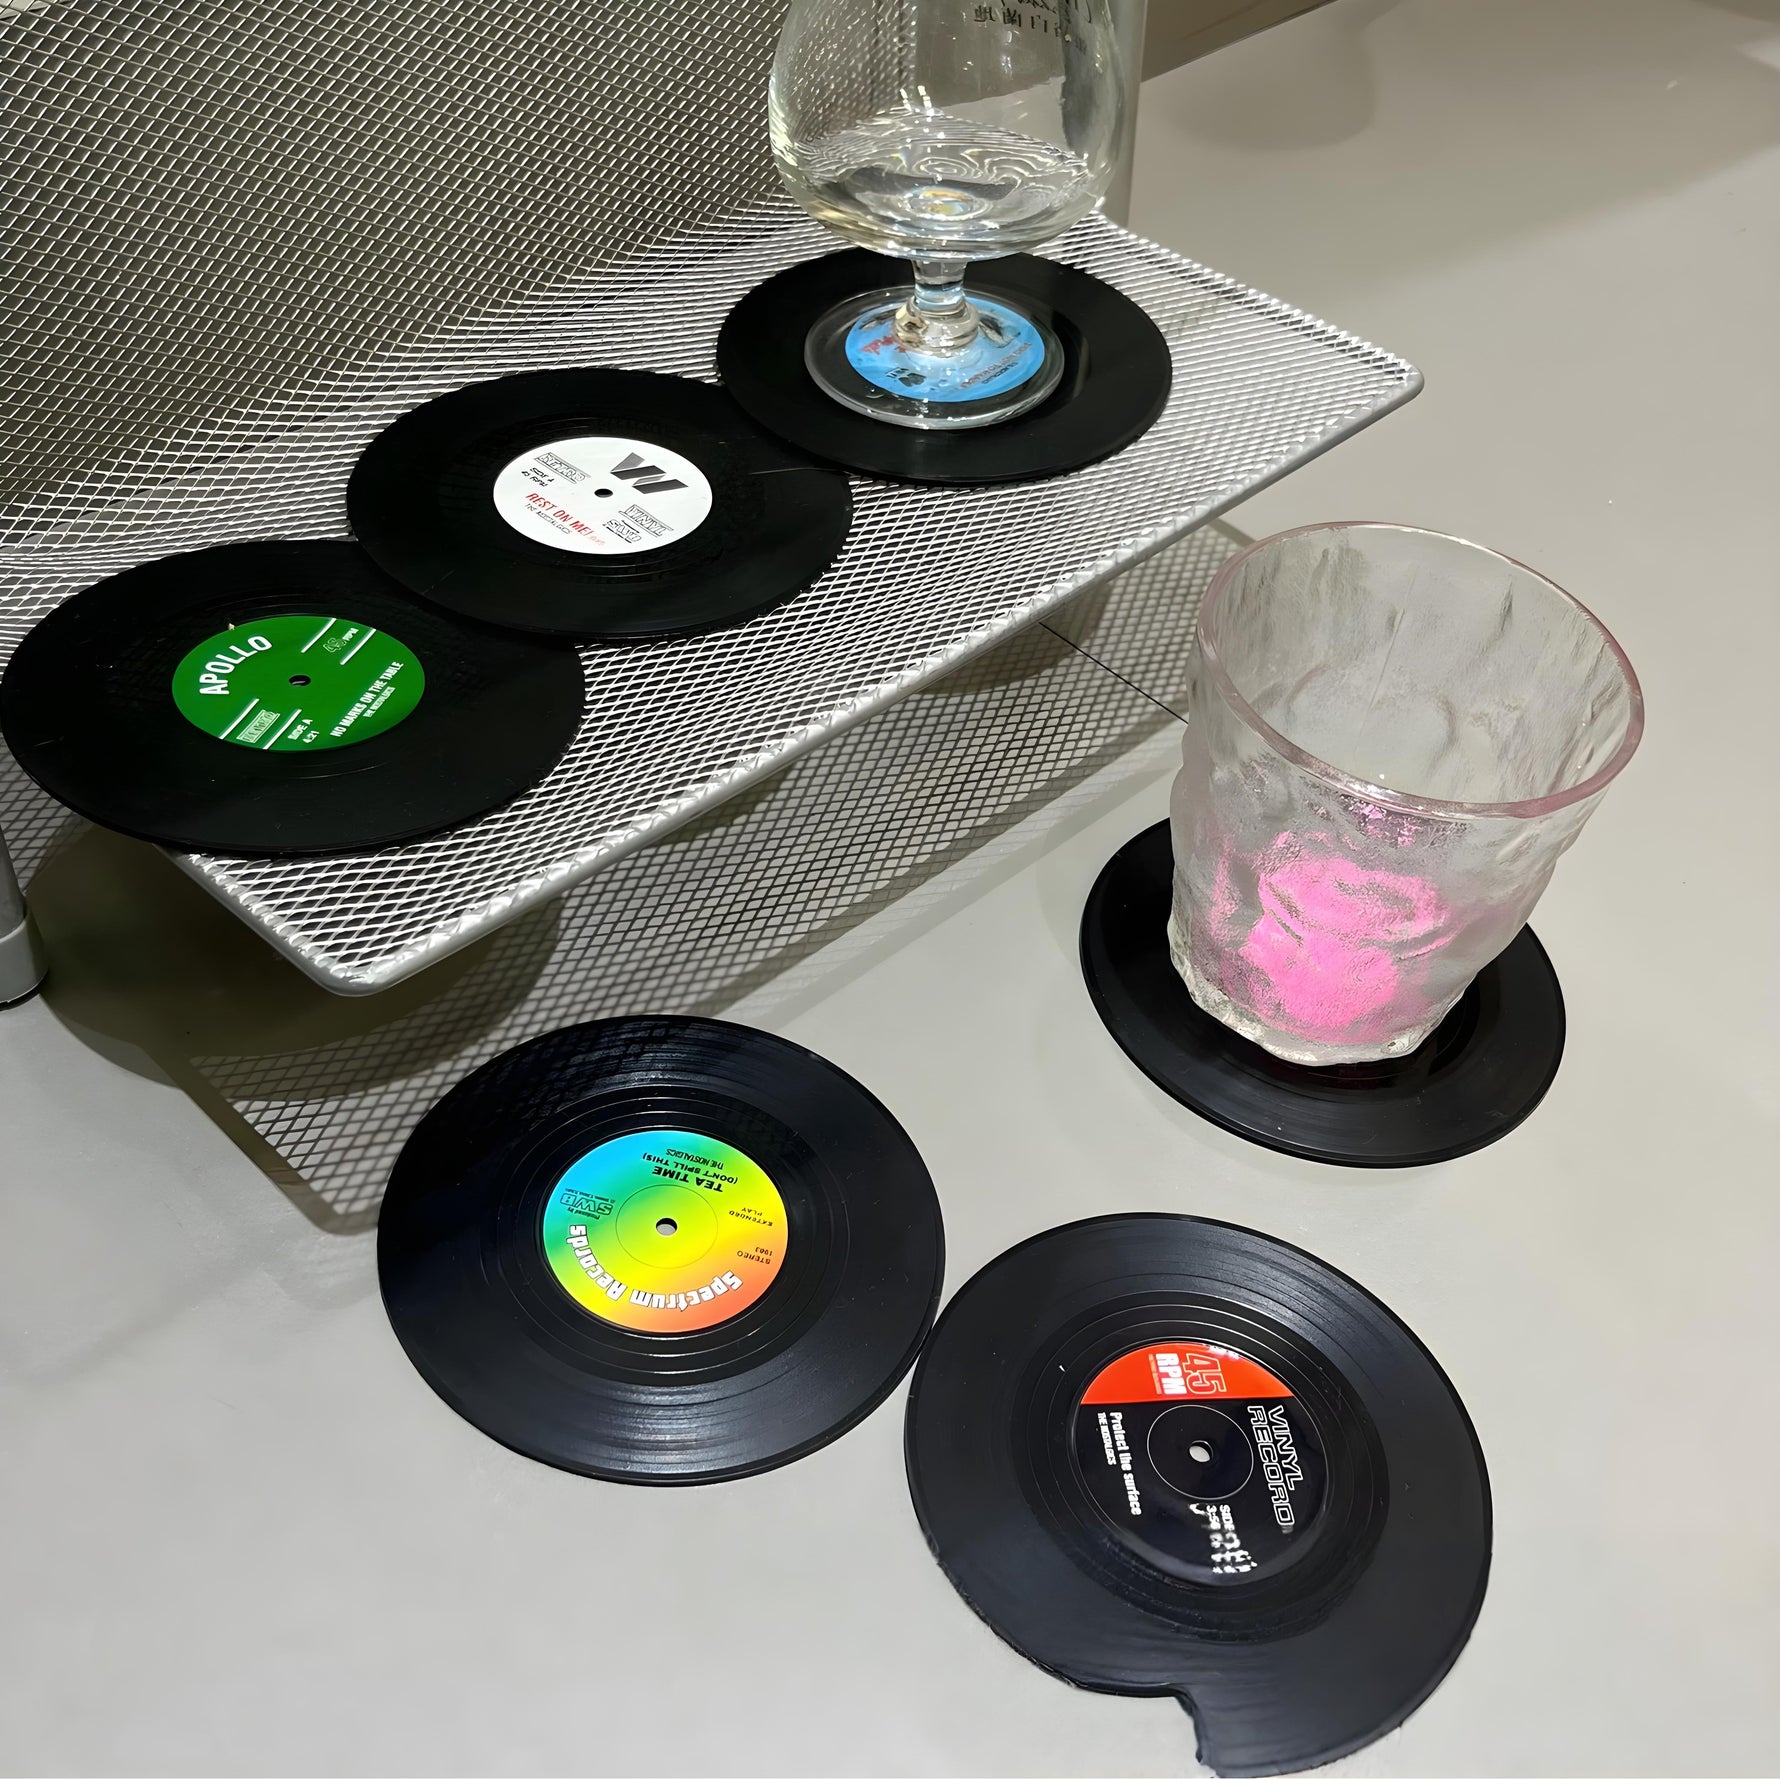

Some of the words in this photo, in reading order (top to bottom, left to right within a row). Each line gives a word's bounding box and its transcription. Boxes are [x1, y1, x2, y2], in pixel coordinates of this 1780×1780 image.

[525, 492, 557, 512] REST
[553, 507, 572, 523] ON
[570, 520, 595, 540] ME!
[199, 635, 273, 694] APOLLO
[379, 661, 404, 682] TABLE
[368, 678, 388, 694] THE
[360, 692, 377, 704] ON
[302, 718, 313, 726] A
[340, 702, 367, 729] MARKS
[330, 725, 346, 738] NO
[643, 1153, 670, 1167] THIS)
[673, 1160, 702, 1174] SPILL
[652, 1166, 690, 1185] TIME
[695, 1176, 724, 1193] TEA
[560, 1193, 614, 1216] SWB
[741, 1206, 763, 1216] PLAY
[728, 1210, 773, 1227] EXTENDED
[566, 1224, 628, 1302] Records
[736, 1250, 771, 1265] STEREO
[629, 1270, 743, 1312] Spectrum
[1155, 1353, 1187, 1395] RPM
[1182, 1353, 1227, 1394] 45
[1110, 1411, 1130, 1452] Protect
[1268, 1405, 1303, 1490] VINYL
[1119, 1452, 1132, 1471] the
[1247, 1405, 1295, 1526] RECORD
[1123, 1472, 1142, 1516] surface
